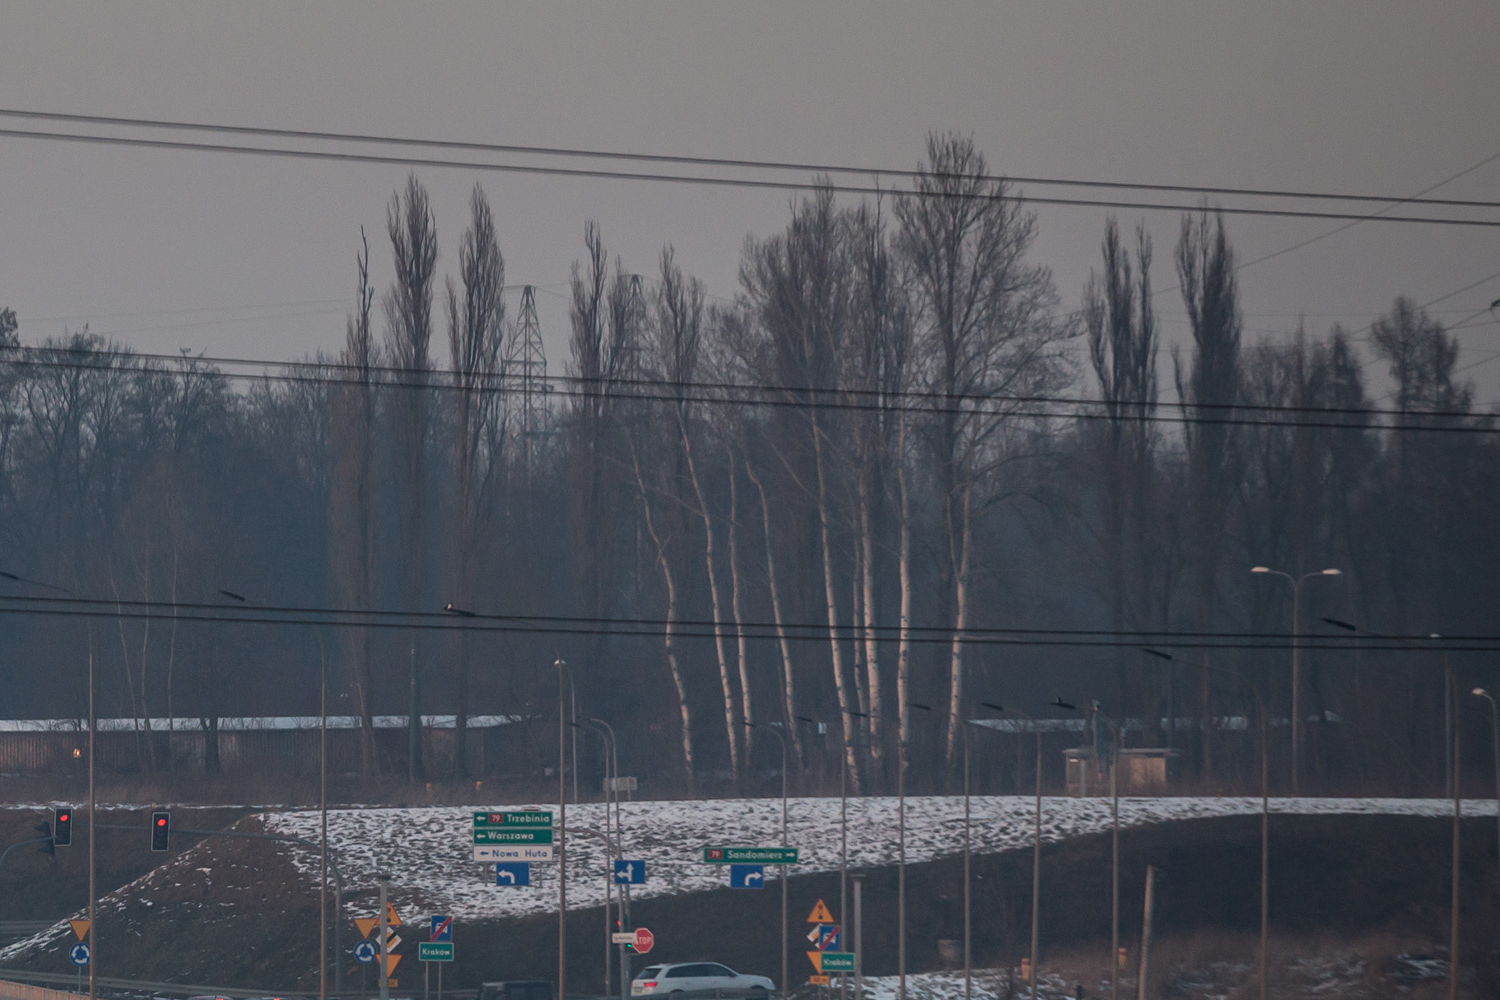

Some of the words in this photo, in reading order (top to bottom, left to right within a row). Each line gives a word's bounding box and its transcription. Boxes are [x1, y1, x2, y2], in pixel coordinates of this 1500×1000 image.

[507, 814, 550, 823] Trzebinia
[488, 832, 534, 840] Warszawa
[492, 849, 519, 858] Nowa
[525, 849, 548, 858] Huta
[712, 850, 720, 858] 79
[727, 850, 782, 859] Sandomierz
[422, 947, 451, 956] Kraków
